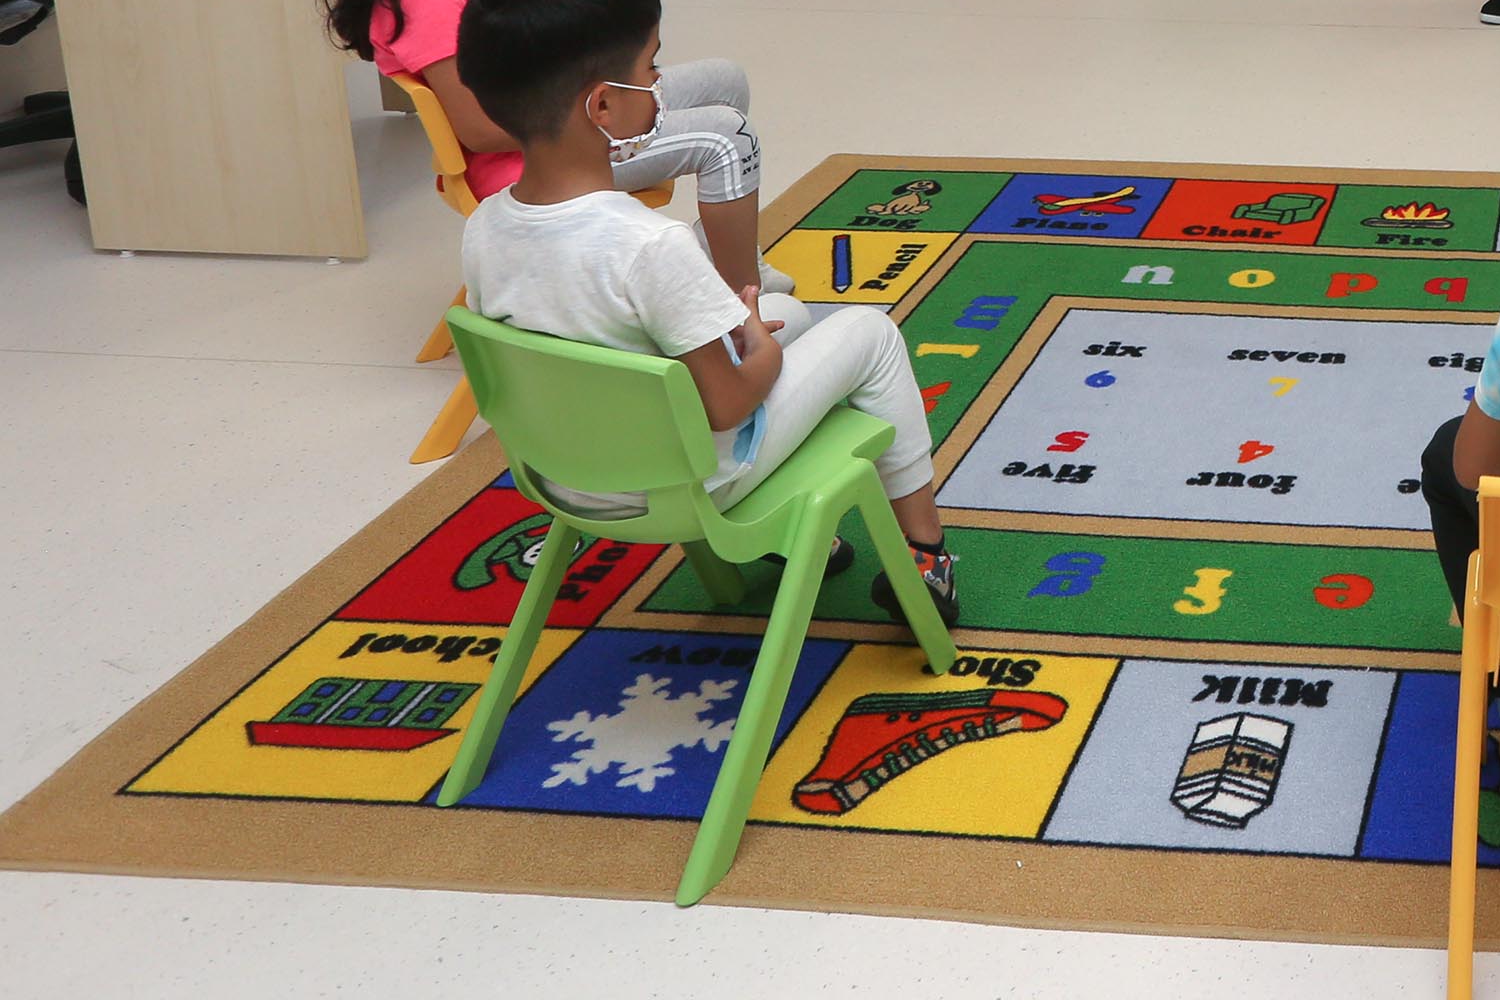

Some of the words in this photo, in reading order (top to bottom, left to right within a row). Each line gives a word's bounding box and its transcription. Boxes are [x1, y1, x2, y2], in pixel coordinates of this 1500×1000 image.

[847, 215, 923, 231] Dog
[1182, 225, 1282, 239] Chair
[1375, 233, 1448, 247] Fire
[859, 243, 928, 291] Pencil
[1120, 264, 1175, 285] n
[1325, 272, 1378, 298] p
[1083, 341, 1148, 358] six
[1227, 349, 1347, 365] seven
[1428, 353, 1485, 373] eig
[1084, 370, 1116, 388] 6
[1268, 376, 1299, 397] 7
[1047, 430, 1090, 453] 5
[1237, 440, 1275, 464] 4
[1002, 461, 1097, 484] five
[1186, 470, 1298, 495] four
[1173, 567, 1233, 615] f
[1313, 573, 1375, 610] e
[338, 632, 500, 664] chool
[629, 643, 757, 672] now
[922, 655, 1042, 687] Sho
